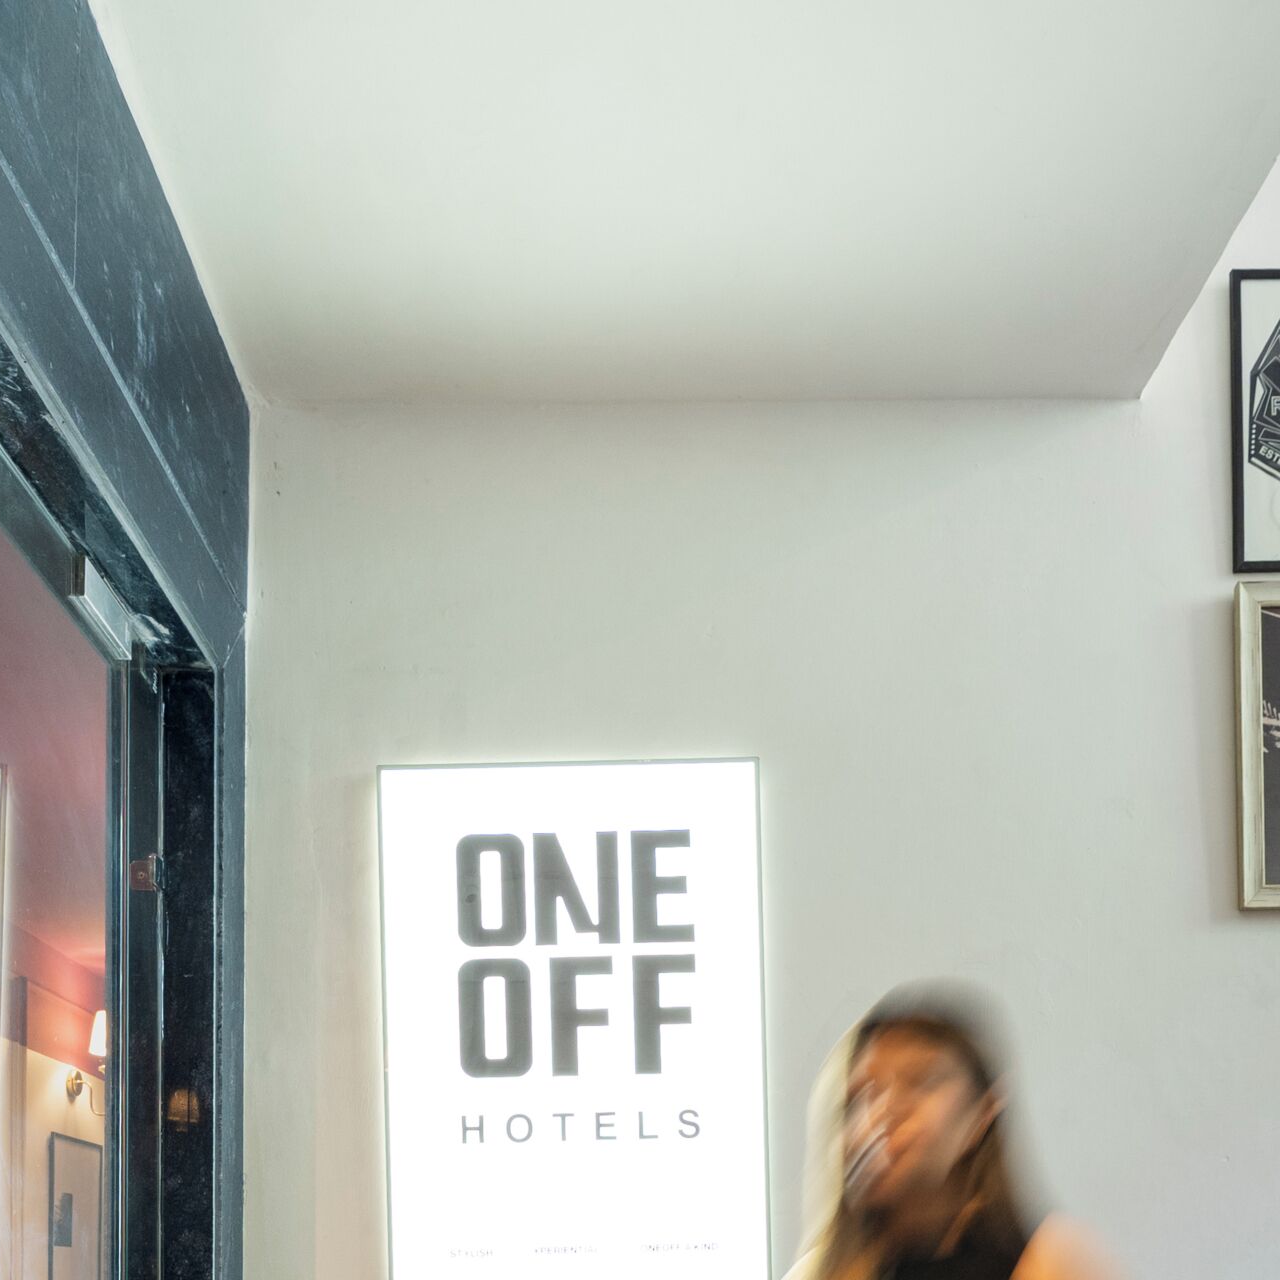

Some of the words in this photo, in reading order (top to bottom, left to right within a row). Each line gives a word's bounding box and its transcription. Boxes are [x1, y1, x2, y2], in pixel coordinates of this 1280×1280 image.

[456, 829, 695, 947] ONE
[458, 954, 696, 1078] OFF
[461, 1109, 701, 1143] HOTELS
